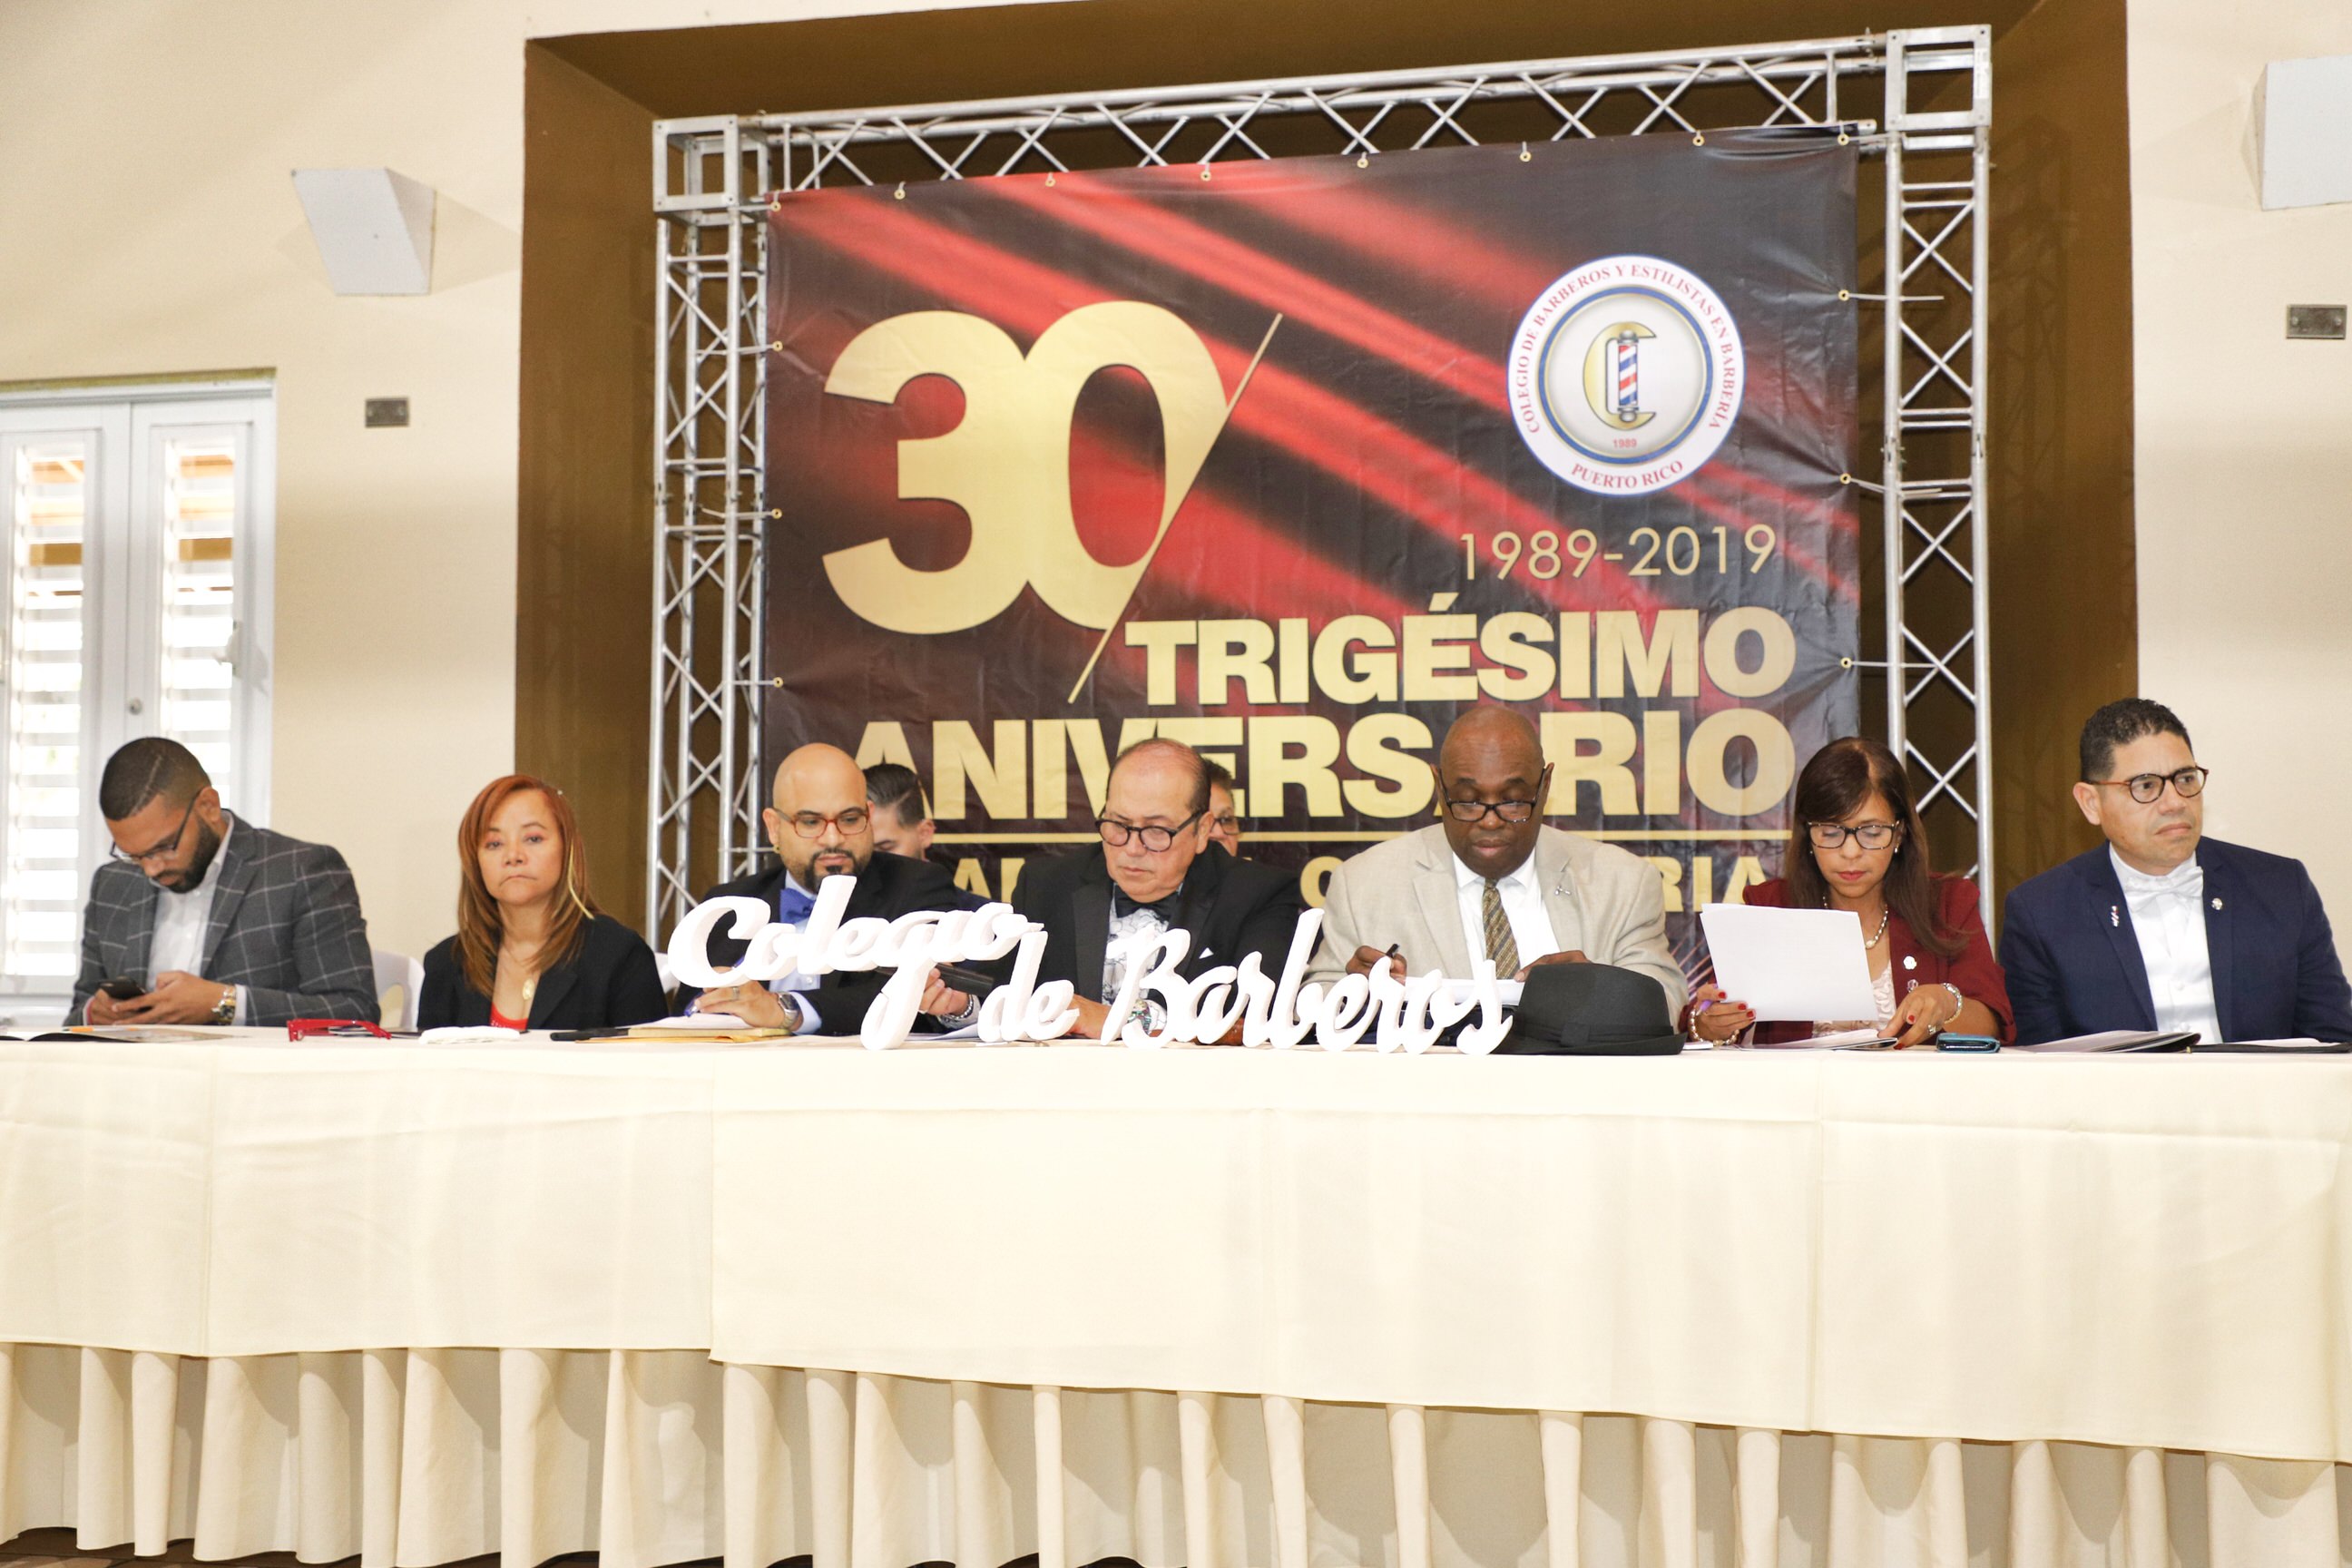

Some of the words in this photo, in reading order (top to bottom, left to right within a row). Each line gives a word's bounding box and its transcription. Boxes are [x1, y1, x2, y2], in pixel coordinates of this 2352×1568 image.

[1533, 267, 1611, 327] BARBEROS
[1615, 263, 1627, 277] Y
[1631, 264, 1716, 316] ESTILISTAS
[1522, 328, 1539, 351] DE
[1710, 316, 1730, 338] EN
[1516, 356, 1540, 433] COLEGIO
[823, 300, 1229, 634] 30
[1612, 437, 1638, 449] 1989
[1572, 464, 1638, 489] PUERTO
[1642, 460, 1683, 486] RICO
[1460, 524, 1777, 581] 1989-2019
[1125, 592, 1797, 704] TRIGÉSIMO
[1100, 907, 1514, 1055] Barberos
